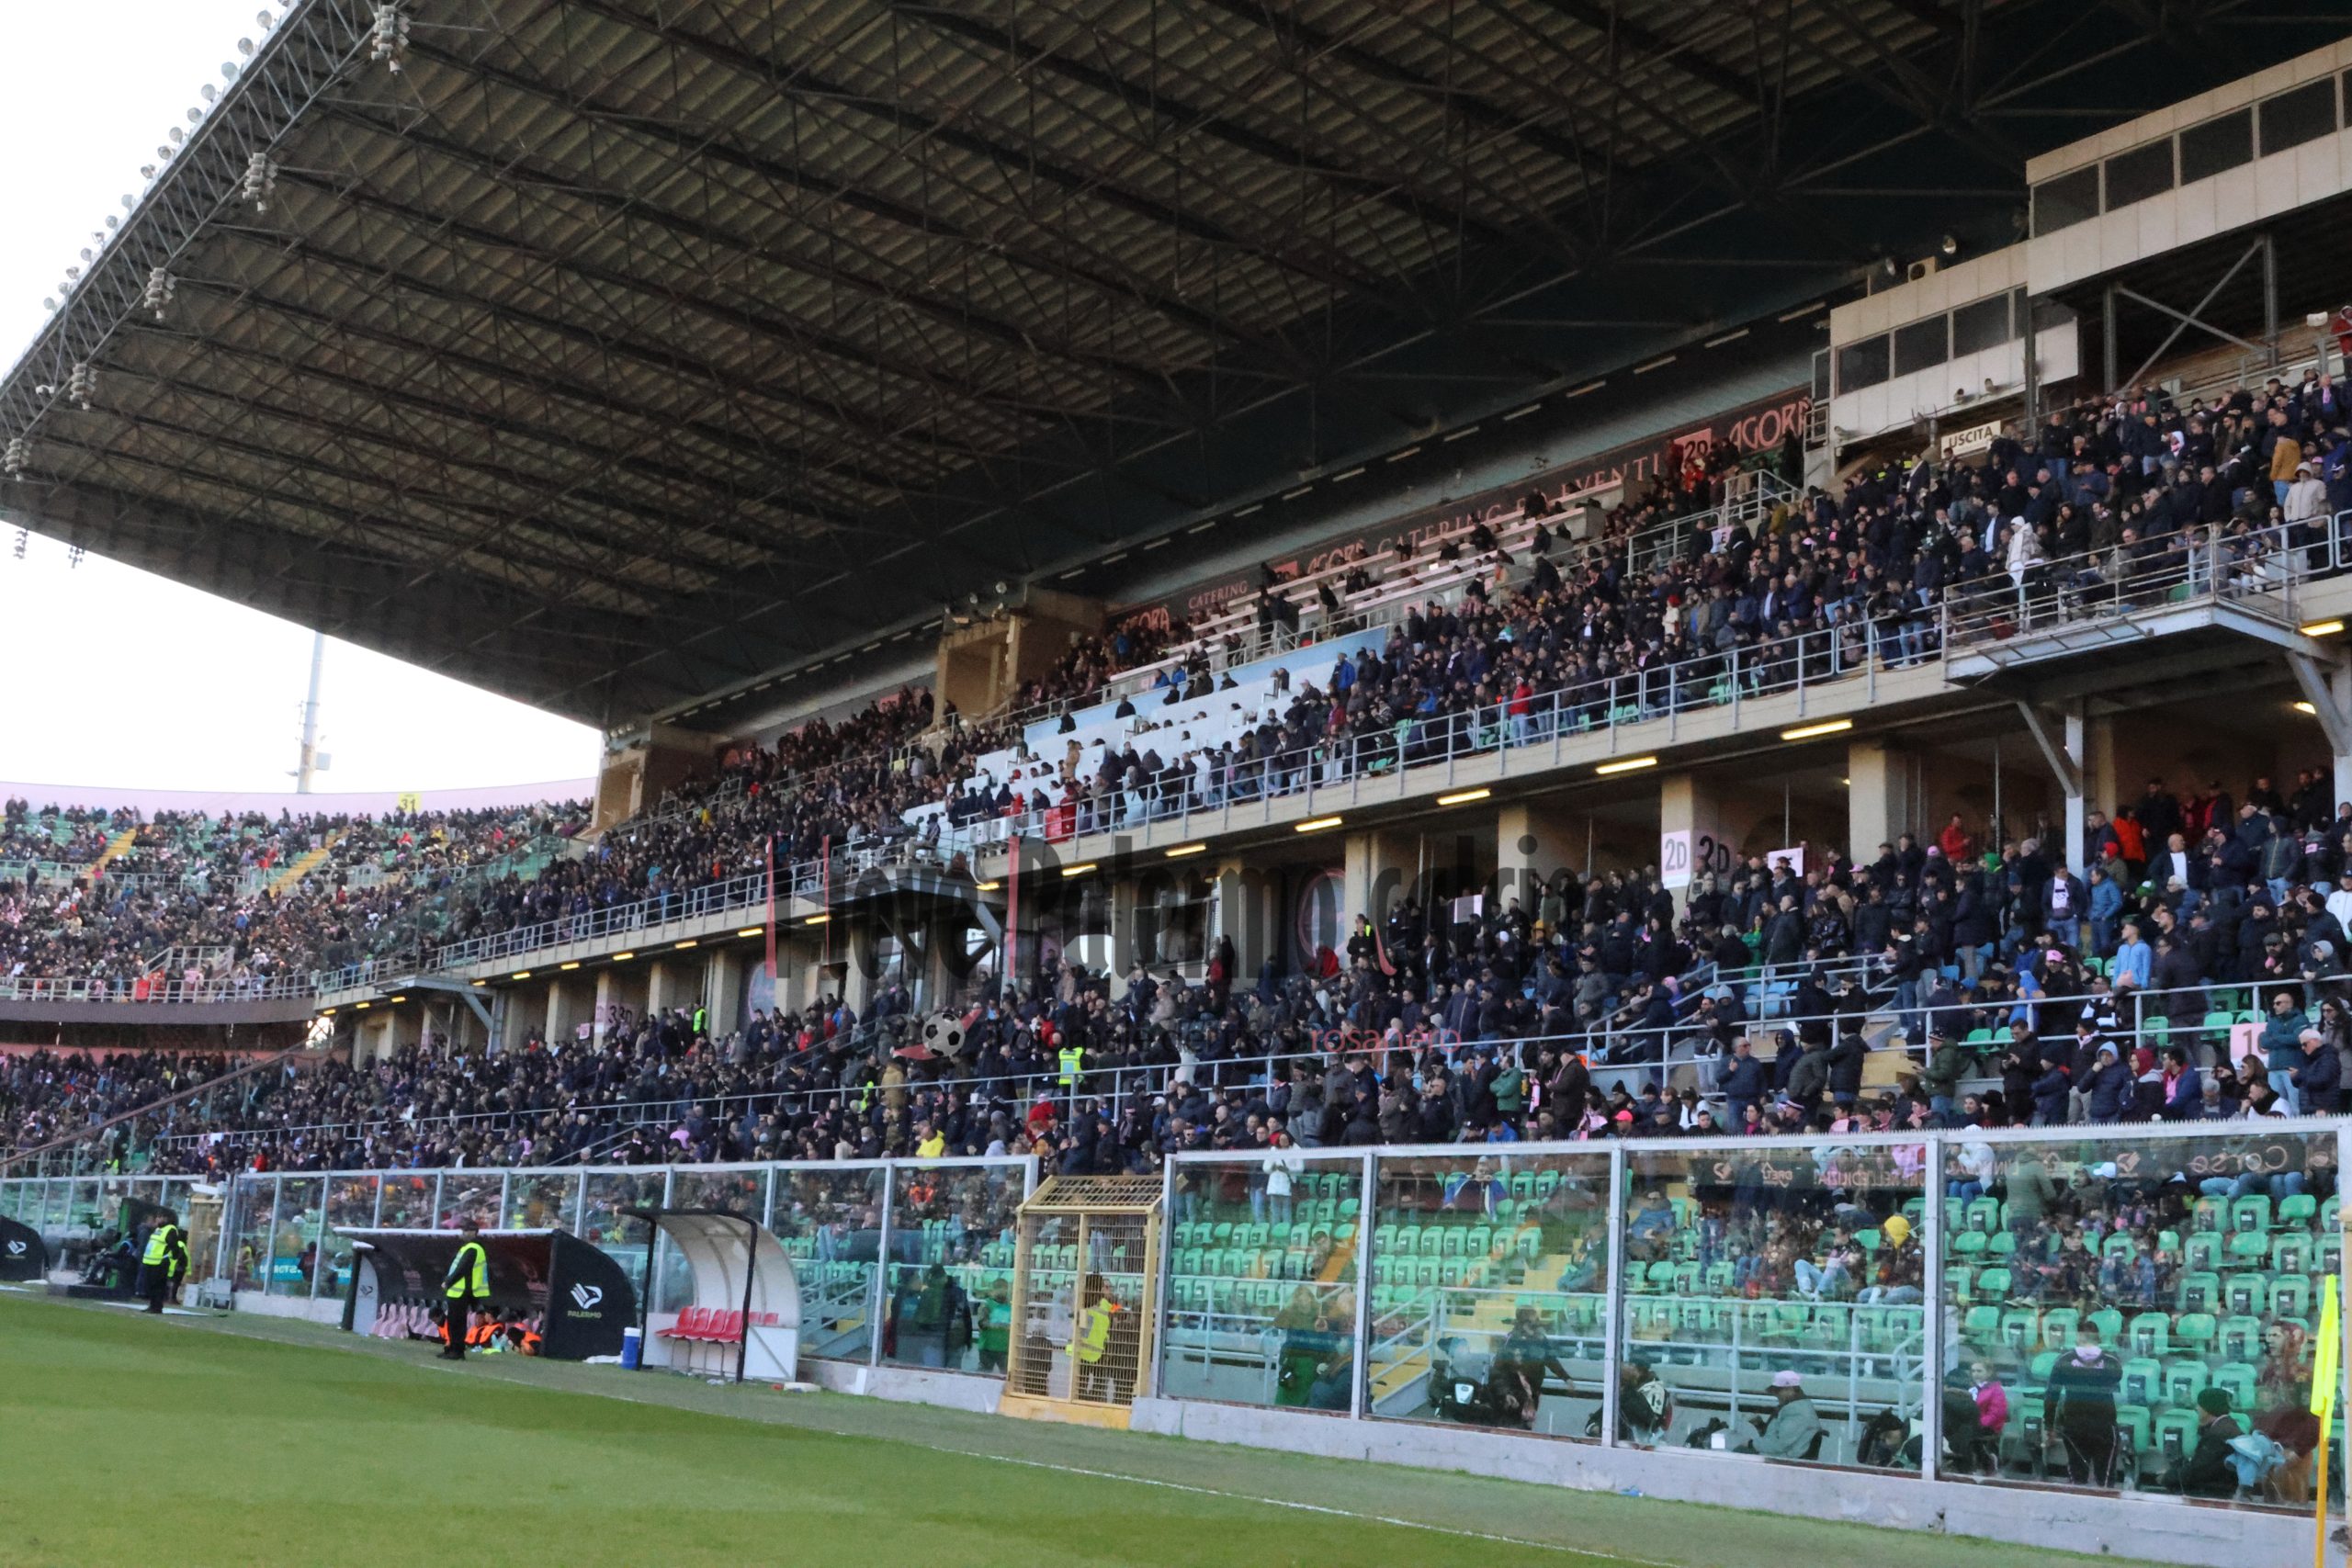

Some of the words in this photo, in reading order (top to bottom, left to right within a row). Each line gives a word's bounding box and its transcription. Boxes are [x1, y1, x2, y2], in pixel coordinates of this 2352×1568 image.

[1949, 425, 1993, 448] USCITA
[1188, 581, 1249, 609] CATERING
[1665, 838, 1687, 871] 2D
